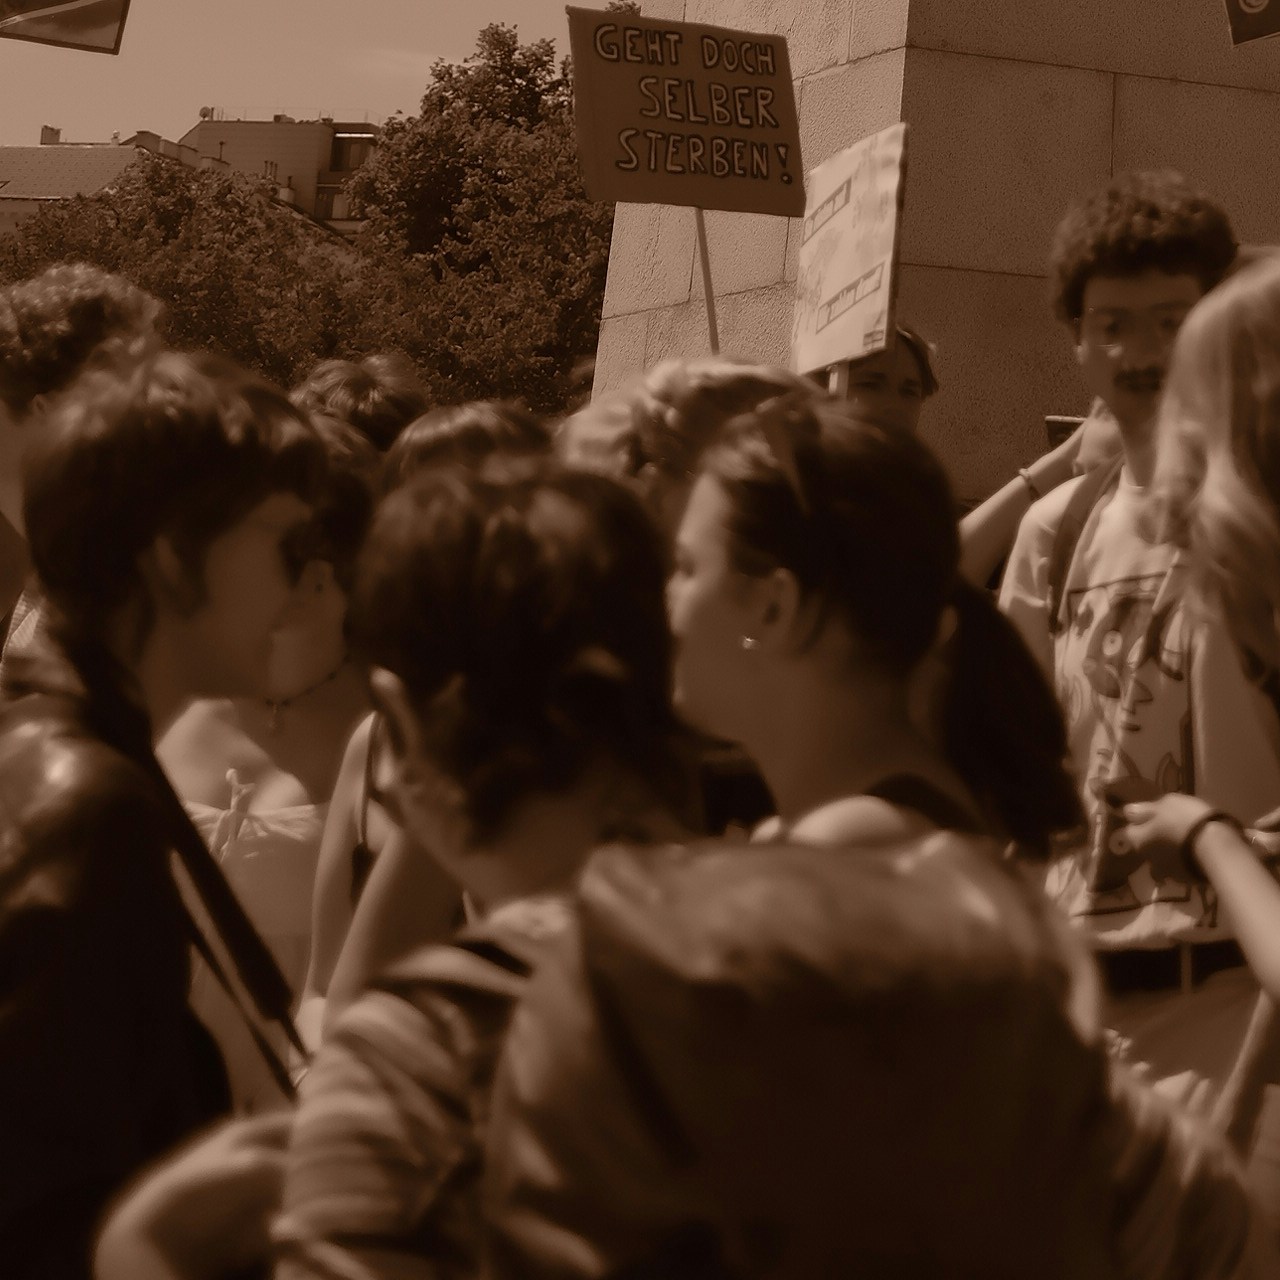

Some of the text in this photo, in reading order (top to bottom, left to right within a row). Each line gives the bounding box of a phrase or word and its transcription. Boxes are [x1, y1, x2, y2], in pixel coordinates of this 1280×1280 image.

[593, 23, 777, 77] GEHT DOCH
[639, 75, 780, 129] SELBER
[615, 127, 793, 185] STERBEN!
